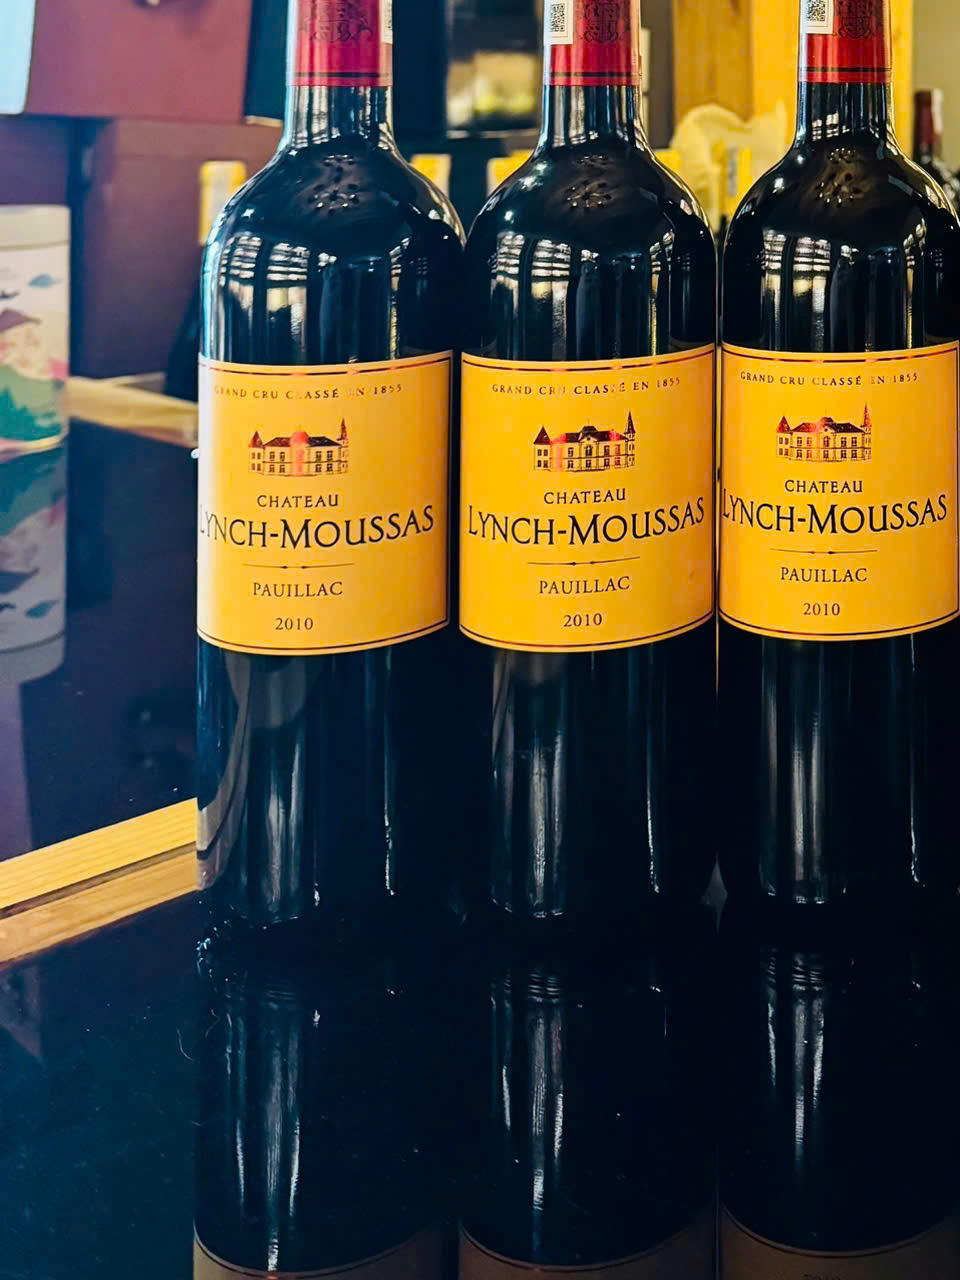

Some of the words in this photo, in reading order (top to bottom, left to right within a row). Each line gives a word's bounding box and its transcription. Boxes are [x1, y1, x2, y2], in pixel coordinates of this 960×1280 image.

[492, 383, 532, 395] GRAND
[574, 382, 626, 395] CLASÉ
[633, 381, 649, 391] EN
[657, 376, 680, 388] 1855
[740, 371, 774, 384] GRAND
[780, 375, 805, 385] CRU
[812, 375, 862, 386] CLASSÉ
[871, 375, 886, 385] EN
[893, 372, 918, 383] 1855
[253, 390, 278, 400] CRU
[286, 388, 339, 400] CASSÉ
[374, 384, 402, 395] 1855
[785, 480, 863, 493] CHATEAU
[257, 494, 339, 508] CHATEAU
[543, 488, 626, 505] CHATEAU
[722, 488, 947, 534] LYNCH-MOUSSAS
[200, 504, 434, 549] LYNCH-MOUSSAS
[468, 496, 704, 545] LYNCH-MOUSSAS
[780, 567, 867, 583] PAUILLAC
[252, 581, 344, 598] PAUILLAC
[539, 576, 630, 595] PAUILLAC
[803, 603, 841, 616] 2010
[275, 617, 313, 631] 2010
[563, 612, 603, 628] 2010
